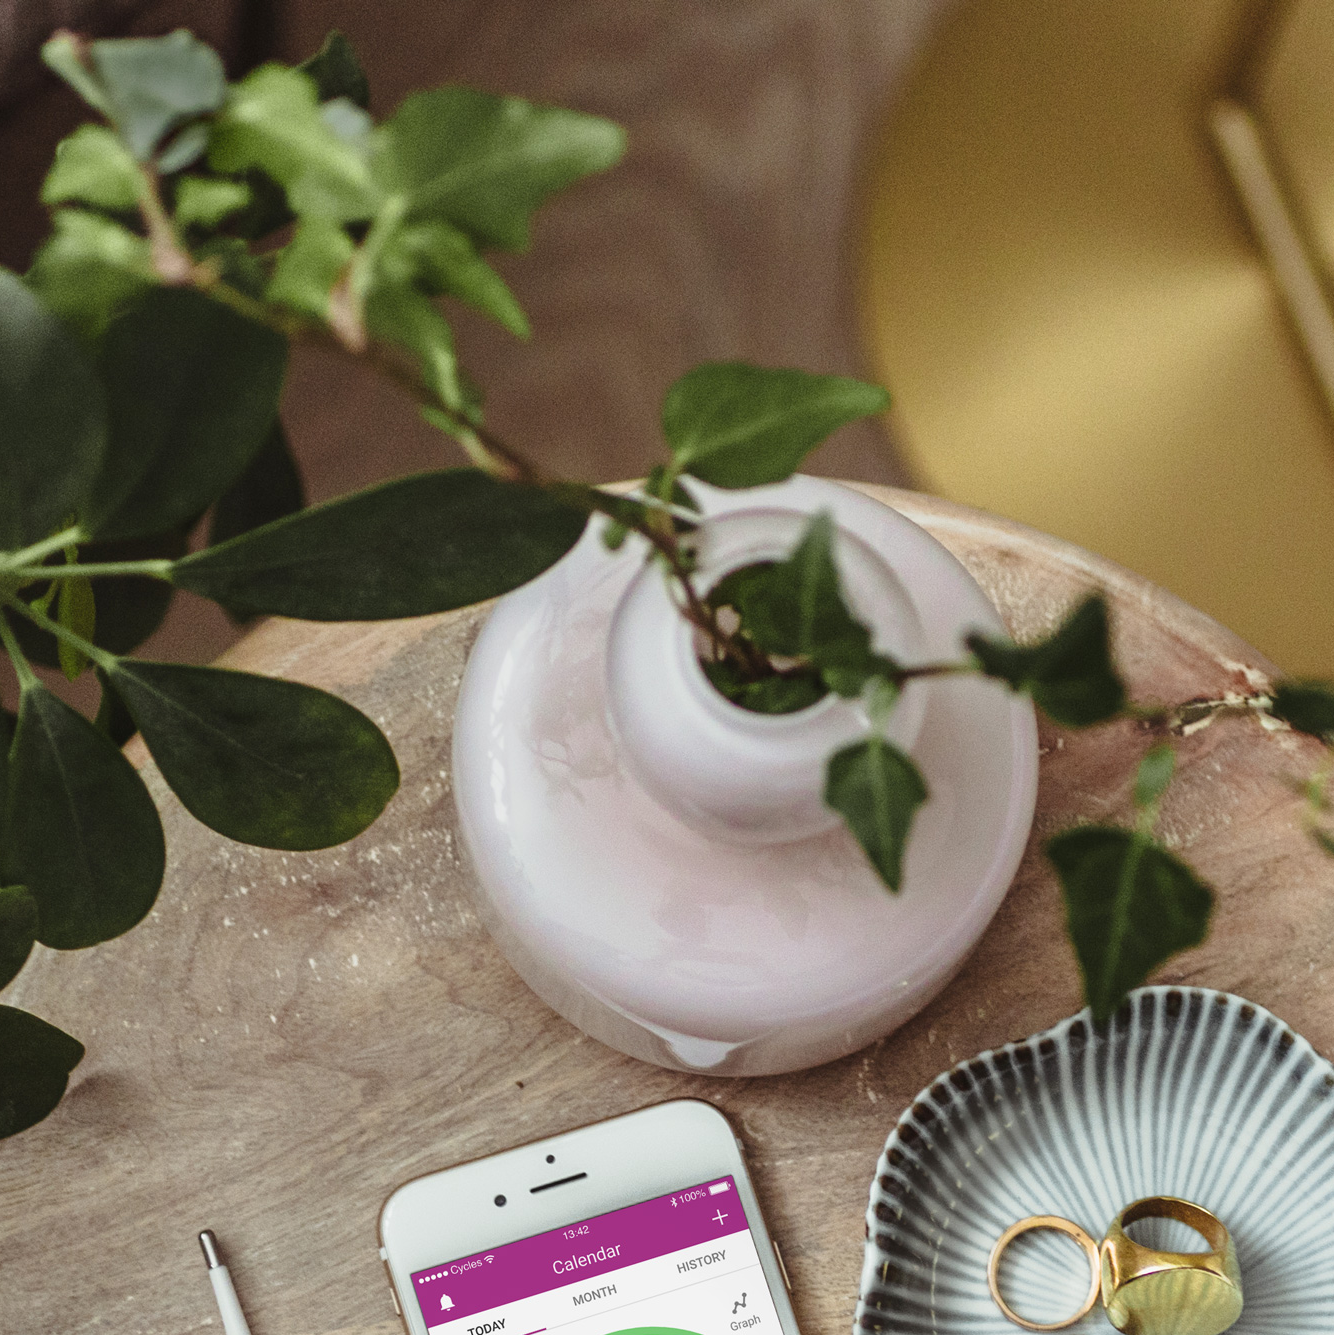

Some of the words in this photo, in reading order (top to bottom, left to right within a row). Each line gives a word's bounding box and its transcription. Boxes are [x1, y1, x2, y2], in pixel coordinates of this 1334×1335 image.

[678, 1189, 706, 1205] 100%
[563, 1225, 590, 1240] 13:42
[450, 1257, 483, 1276] Cycles
[552, 1244, 622, 1275] Calendar
[676, 1250, 727, 1274] HISTORY
[572, 1284, 618, 1306] MONTH
[730, 1314, 762, 1333] Graph
